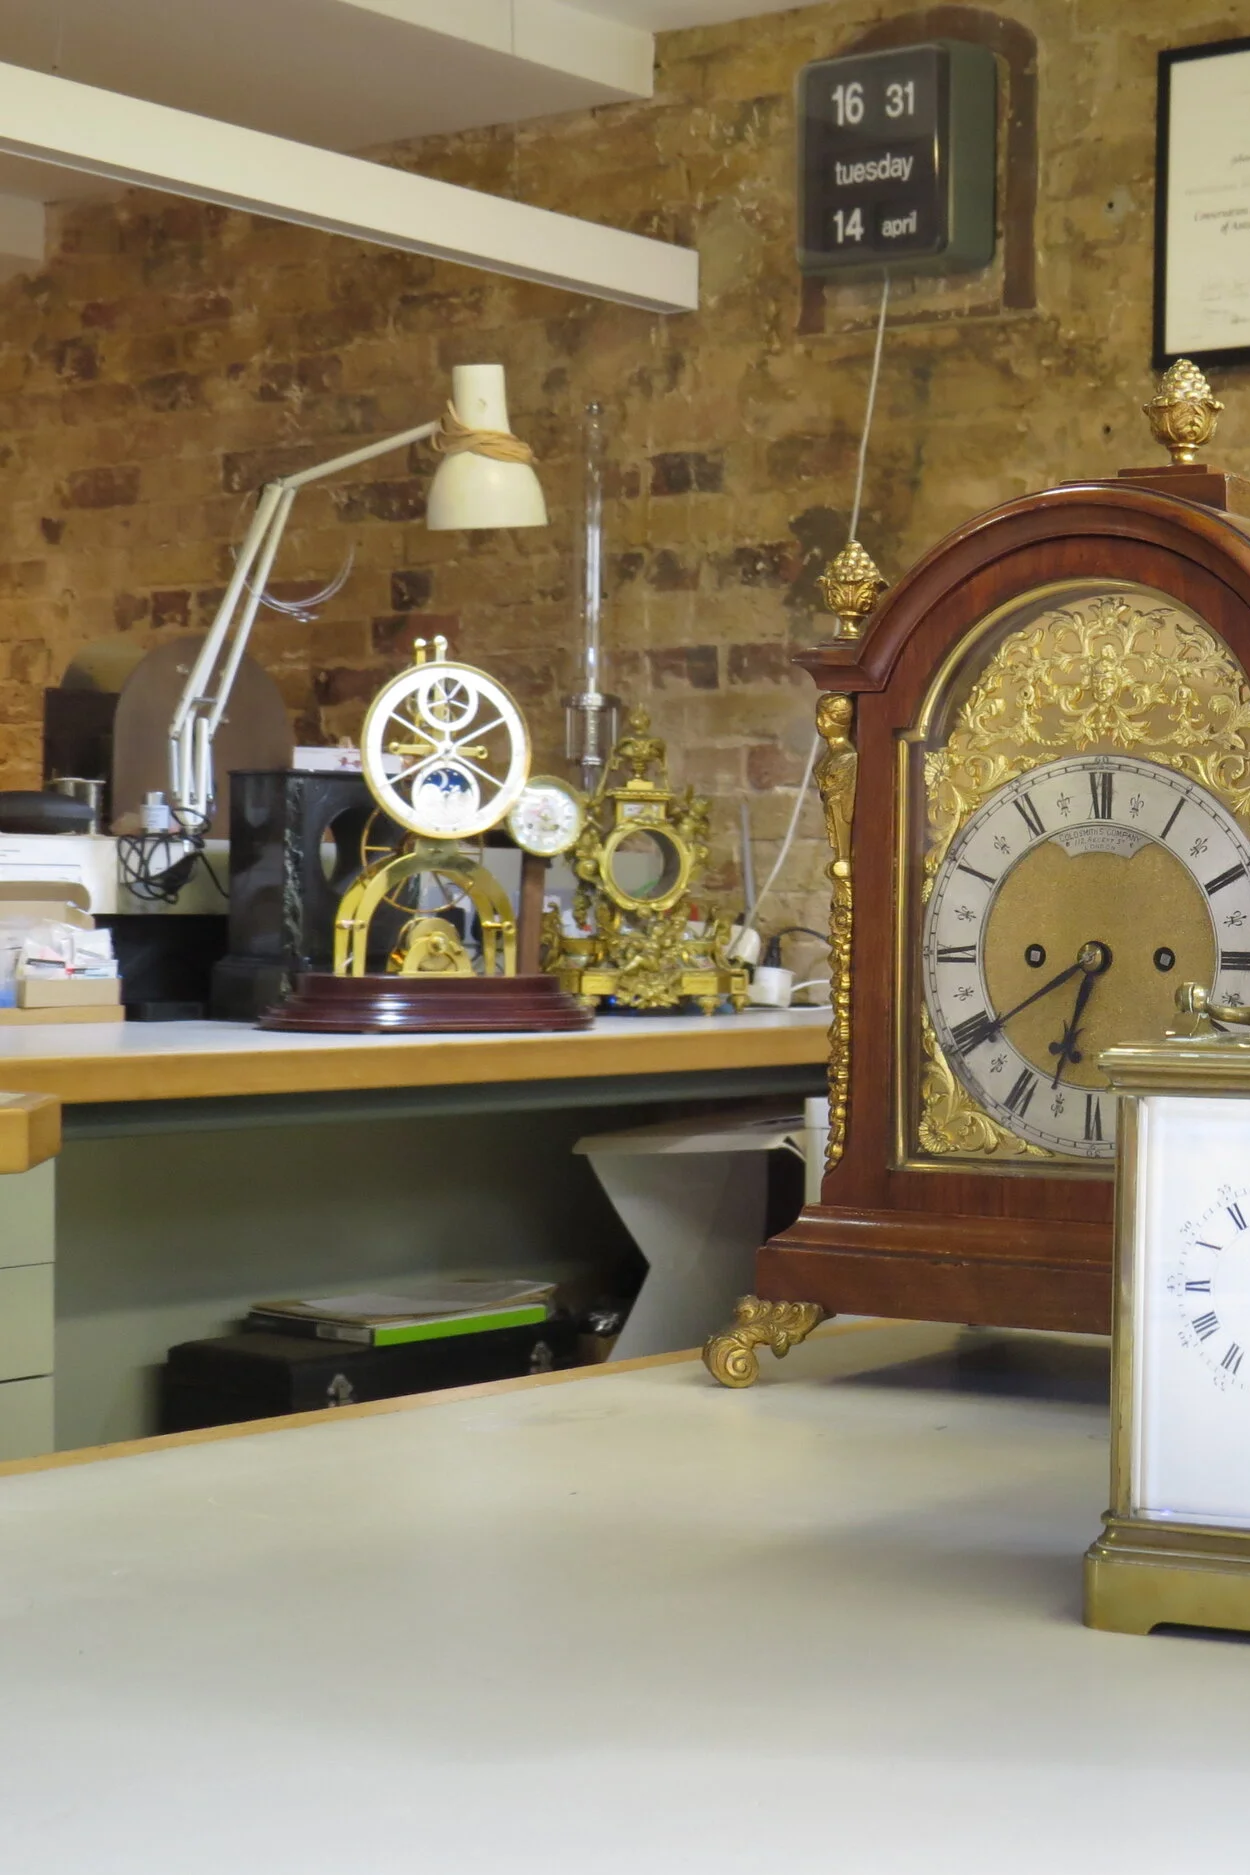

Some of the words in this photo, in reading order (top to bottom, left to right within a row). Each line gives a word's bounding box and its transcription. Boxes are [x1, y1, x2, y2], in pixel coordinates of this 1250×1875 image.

[832, 82, 864, 126] 16
[885, 81, 914, 117] 31
[835, 152, 913, 185] tuesday
[833, 207, 864, 243] 14
[882, 209, 917, 238] april
[1013, 792, 1047, 842] XI
[1159, 796, 1187, 840] I
[1203, 860, 1248, 897] II
